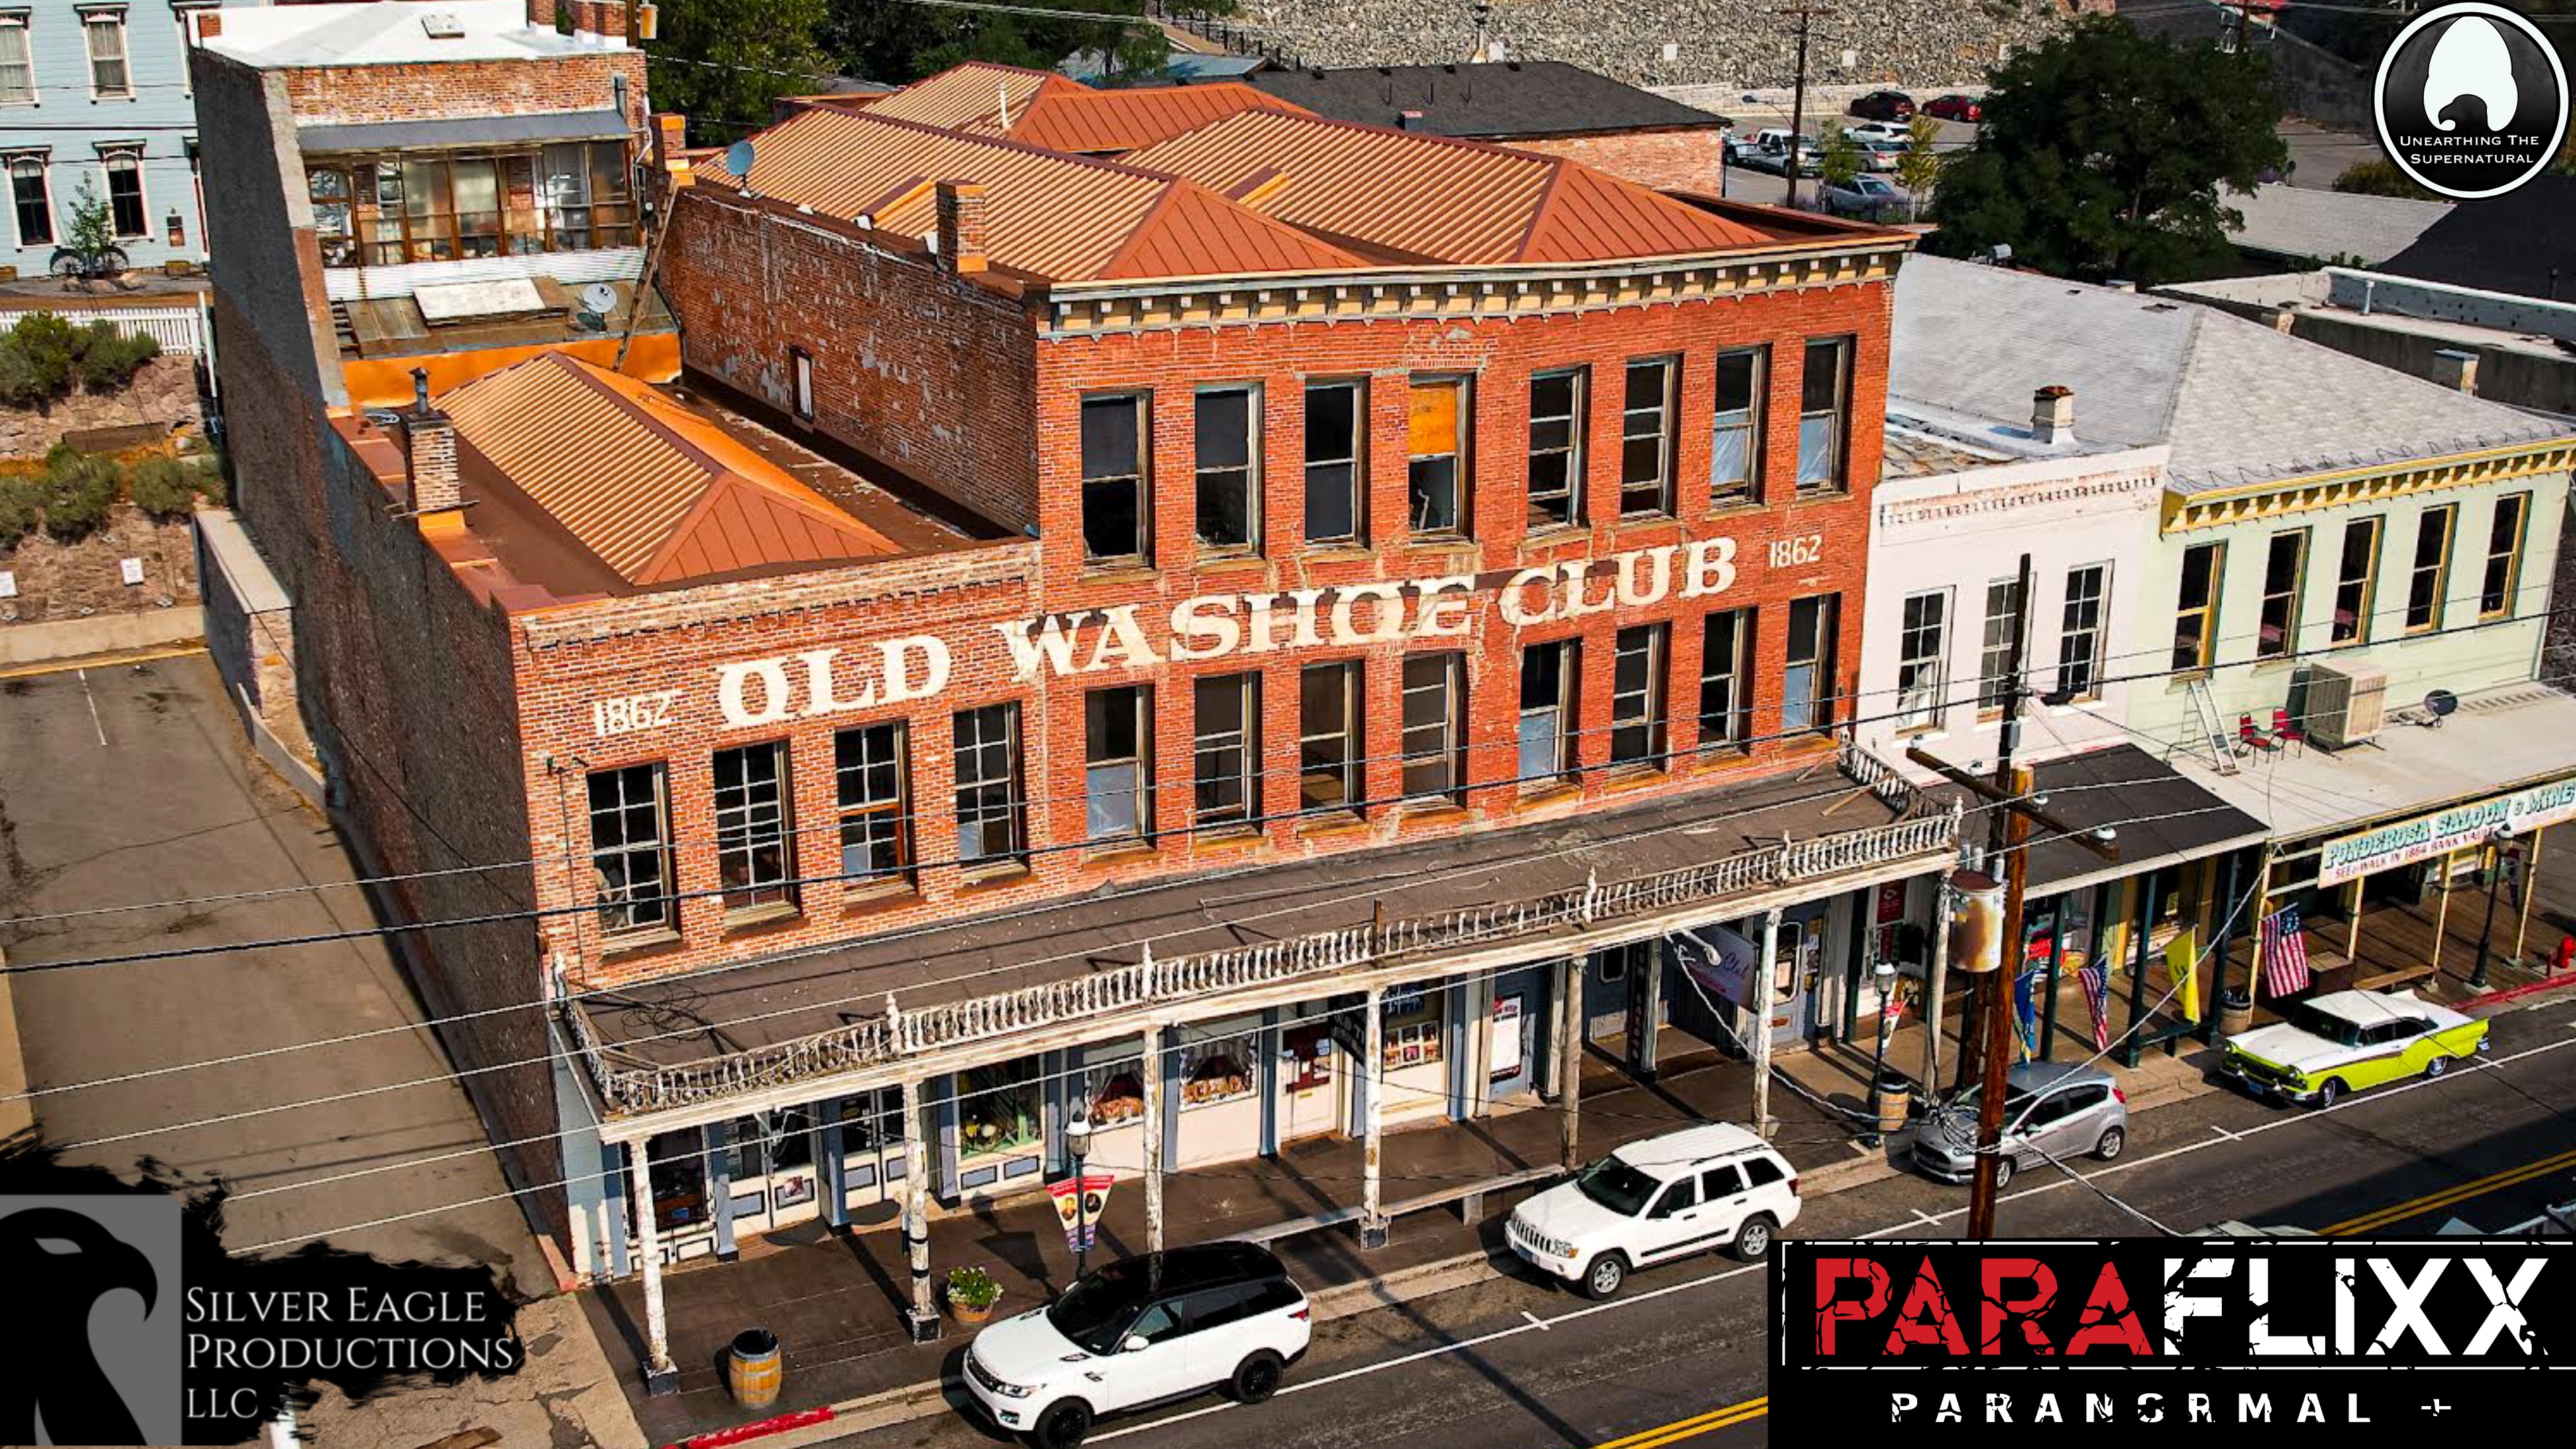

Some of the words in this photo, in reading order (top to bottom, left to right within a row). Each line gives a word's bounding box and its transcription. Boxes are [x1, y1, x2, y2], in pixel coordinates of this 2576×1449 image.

[593, 688, 679, 737] 1862
[716, 635, 953, 730] OLD
[994, 572, 1476, 683] WASHOE
[1499, 536, 1737, 628] CLUB
[1770, 535, 1823, 568] 1862
[2325, 820, 2430, 869] PONDEROSA
[2435, 798, 2511, 838] SALOON
